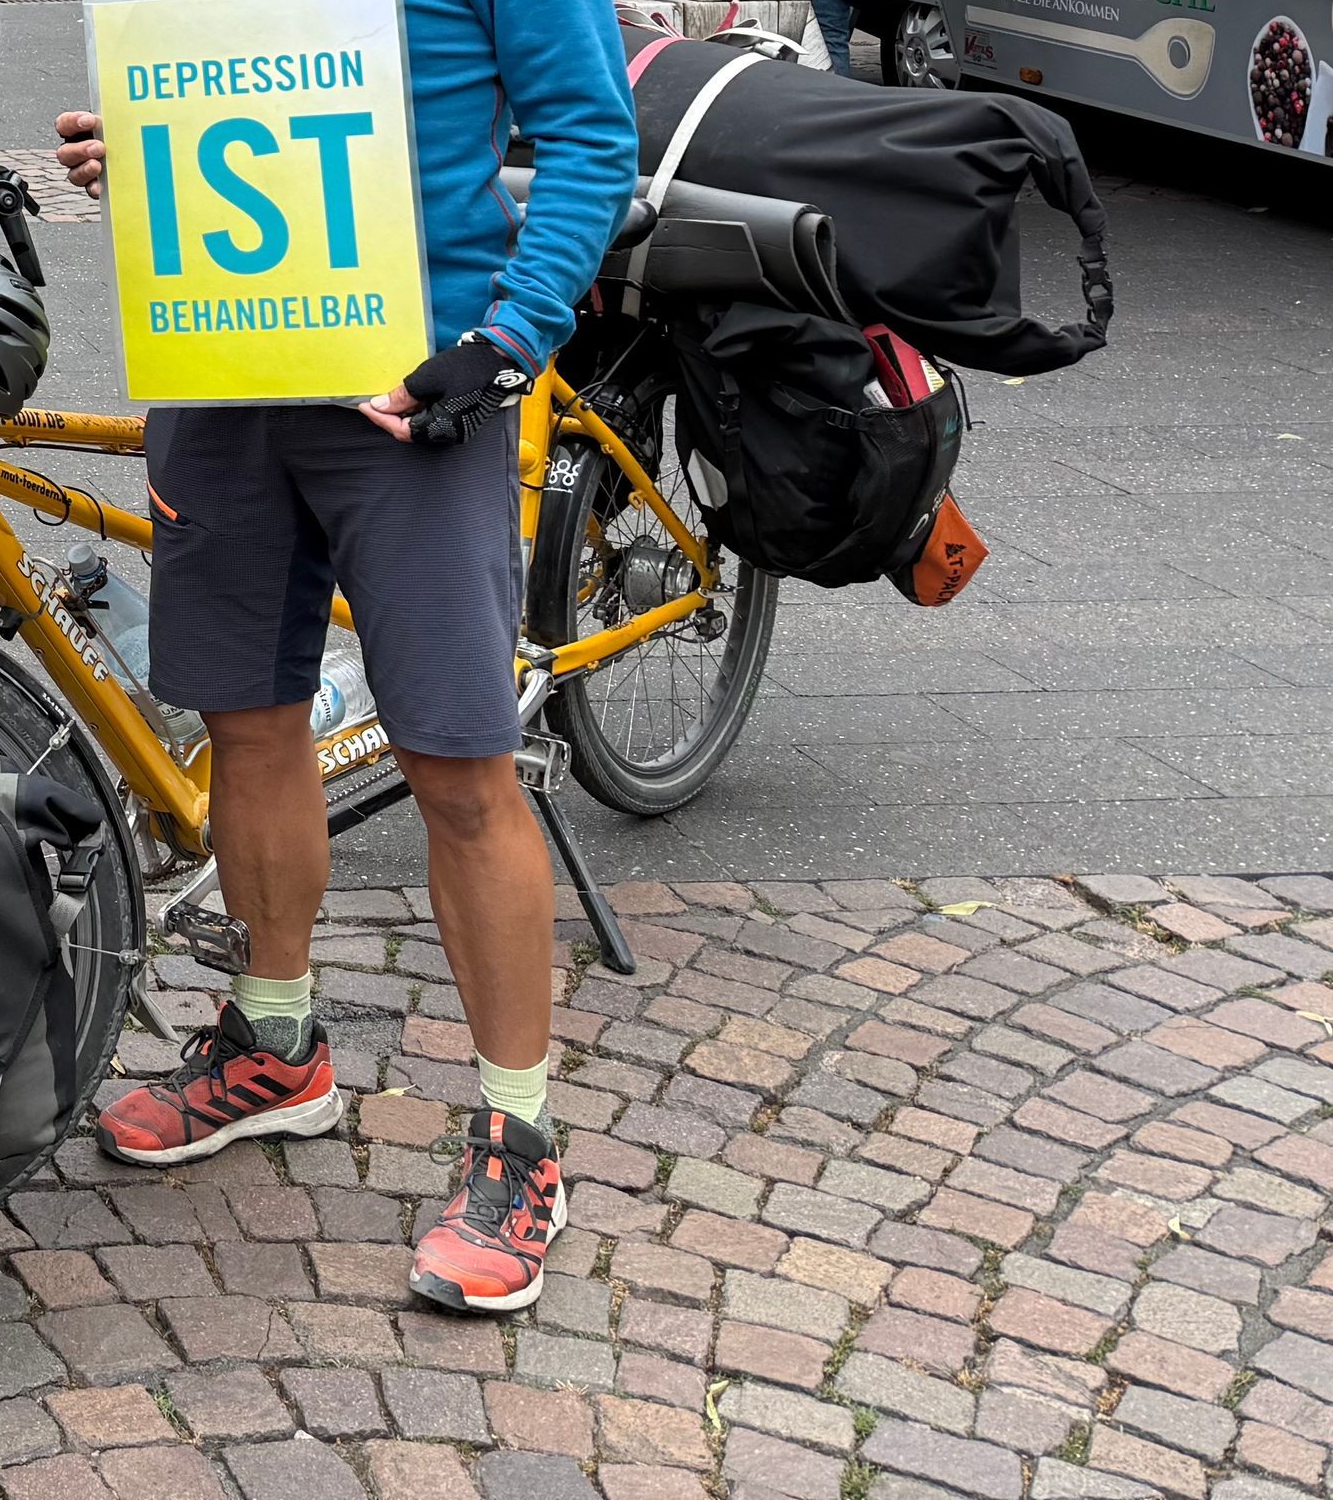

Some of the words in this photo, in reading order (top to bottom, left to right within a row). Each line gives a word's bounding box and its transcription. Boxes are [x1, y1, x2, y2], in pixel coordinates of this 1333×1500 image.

[127, 50, 364, 101] DEPRESSION
[140, 111, 374, 276] IST
[150, 293, 386, 333] BEHANDELBAR
[16, 551, 110, 682] SCHAUFF
